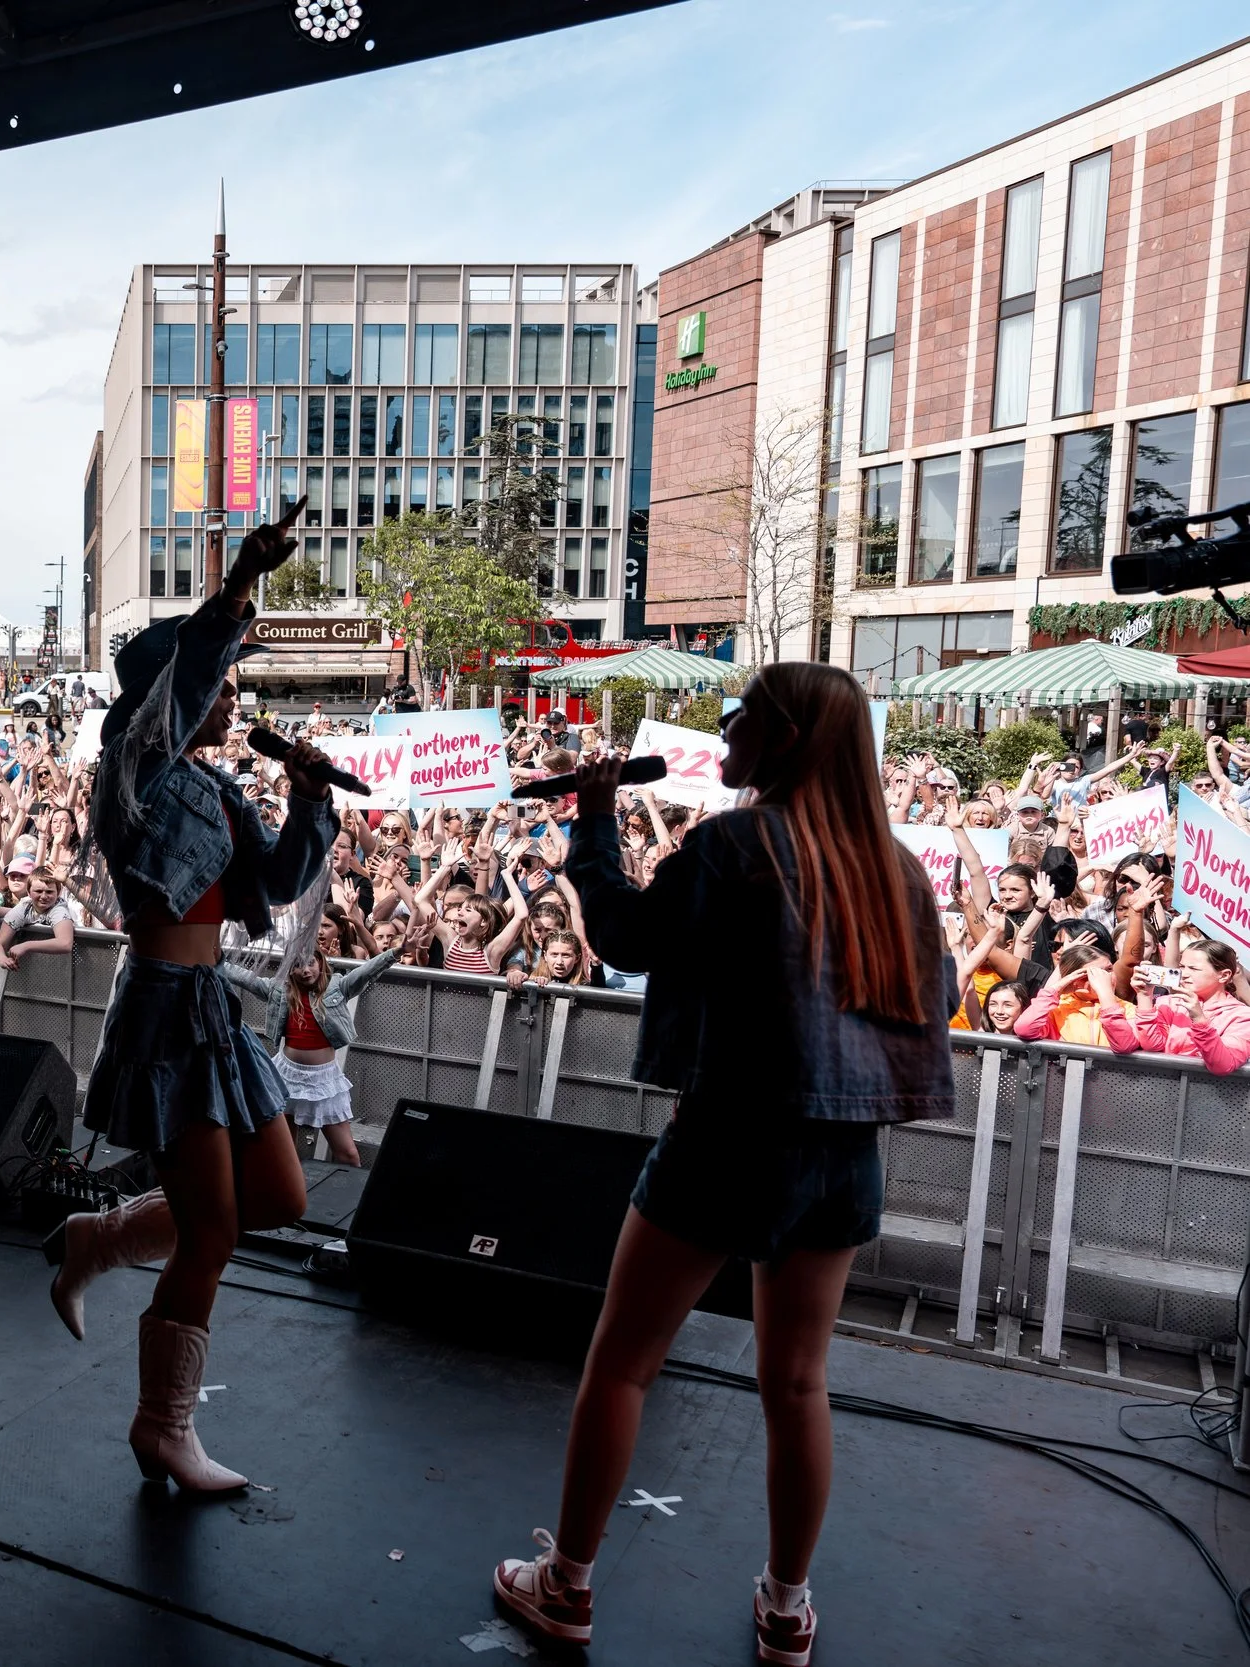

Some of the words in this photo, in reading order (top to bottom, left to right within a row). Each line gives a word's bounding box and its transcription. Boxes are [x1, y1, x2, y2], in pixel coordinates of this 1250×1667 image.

[665, 368, 698, 389] Holiday
[698, 363, 717, 380] Inn
[233, 405, 251, 453] EVENTS
[232, 456, 251, 483] LIVE
[255, 623, 327, 638] Gourmet
[332, 623, 368, 638] Grill
[399, 728, 480, 758] orthern
[410, 754, 490, 788] aughters
[1181, 860, 1250, 930] Daugh
